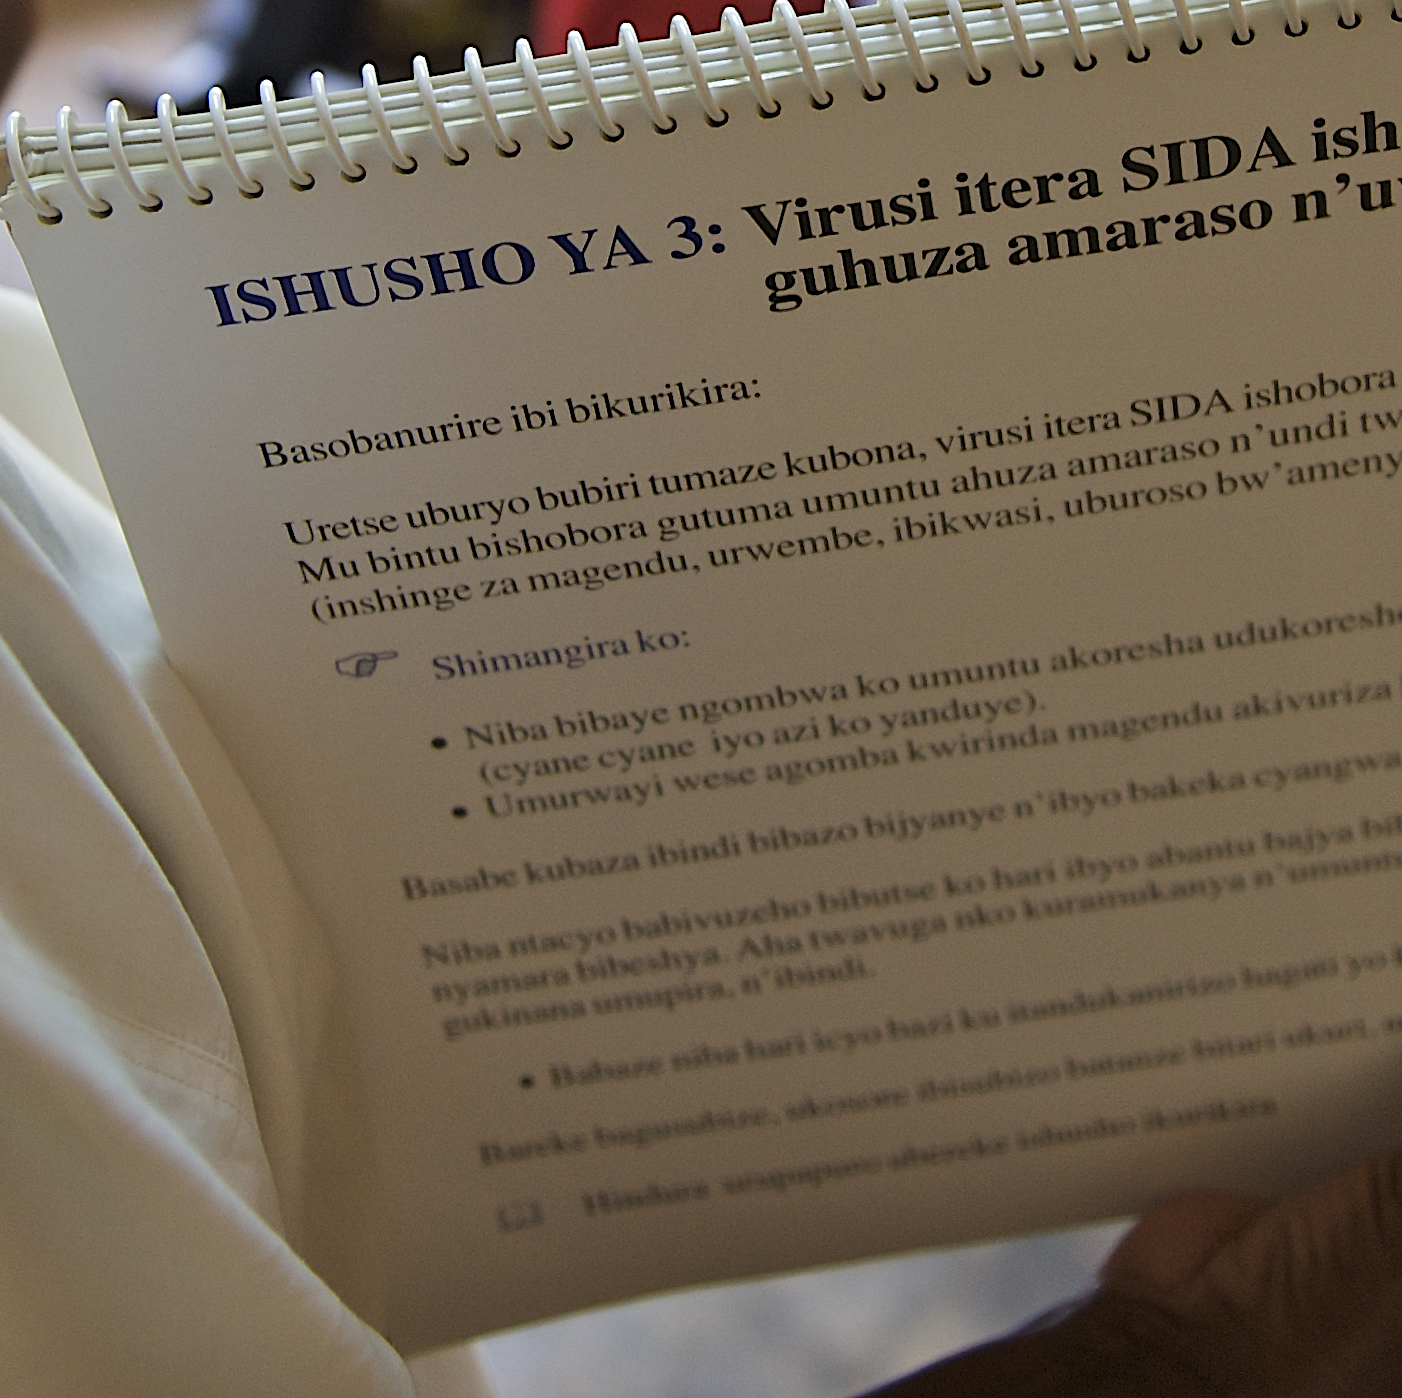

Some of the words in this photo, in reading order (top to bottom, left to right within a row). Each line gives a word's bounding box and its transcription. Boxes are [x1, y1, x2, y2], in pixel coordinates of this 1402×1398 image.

[205, 241, 536, 327] ISHUSHO
[548, 224, 652, 276] YA
[667, 214, 725, 260] 3:
[741, 177, 938, 246] Virusi
[955, 167, 1103, 217] itera
[1121, 126, 1296, 194] SIDA
[765, 241, 990, 314] guhuza
[1008, 198, 1273, 267] amaraso
[258, 413, 501, 469] Basobanurire
[510, 399, 558, 432] ibi
[565, 377, 760, 424] bikurikira:
[284, 515, 398, 546] Uretse
[406, 496, 530, 530] uburyo
[535, 472, 641, 511] bubiri
[648, 461, 776, 497] tumaze
[783, 441, 927, 478] kubona,
[935, 415, 1033, 455] virusi
[1044, 411, 1121, 440] itera
[1130, 388, 1233, 427] SIDA
[1245, 370, 1396, 411] ishobora
[297, 555, 360, 585] Mu
[366, 545, 460, 574] bintu
[467, 520, 648, 561] bishobora
[658, 500, 793, 543] gutuma
[802, 479, 940, 516] umuntu
[952, 462, 1057, 495] ahuza
[1068, 438, 1220, 477] amaraso
[311, 584, 470, 622] (inshinge
[484, 578, 519, 598] za
[528, 549, 700, 593] magendu,
[708, 526, 884, 568] urwembe,
[894, 497, 1054, 543] ibikwasi,
[1064, 481, 1207, 518] uburoso
[432, 636, 629, 680] Shimangira
[636, 629, 689, 653] ko:
[464, 720, 548, 749] Niba
[554, 707, 668, 737] bibaye
[679, 684, 848, 725] ngombwa
[856, 674, 900, 698] ko
[909, 658, 1040, 691] umuntu
[1051, 633, 1204, 673] akoresha
[480, 755, 588, 786] (cyane
[598, 740, 694, 773] cyane
[713, 731, 765, 758] iyo
[774, 723, 820, 745] azi
[828, 714, 871, 737] ko
[880, 693, 1045, 737] yanduye).
[485, 780, 663, 818] Umurwayi
[674, 768, 754, 792] wese
[766, 746, 898, 785] agomba
[907, 724, 1058, 762] kwirinda
[1068, 702, 1223, 741] magendu
[1234, 683, 1391, 720] akivuriza
[401, 868, 516, 901] Basabe
[524, 854, 640, 885] kubaza
[648, 835, 741, 868] ibindi
[747, 825, 858, 854] bibazo
[863, 805, 1004, 840] bijyanye
[1128, 771, 1246, 803] bakeka
[1253, 753, 1401, 789] cyangwa
